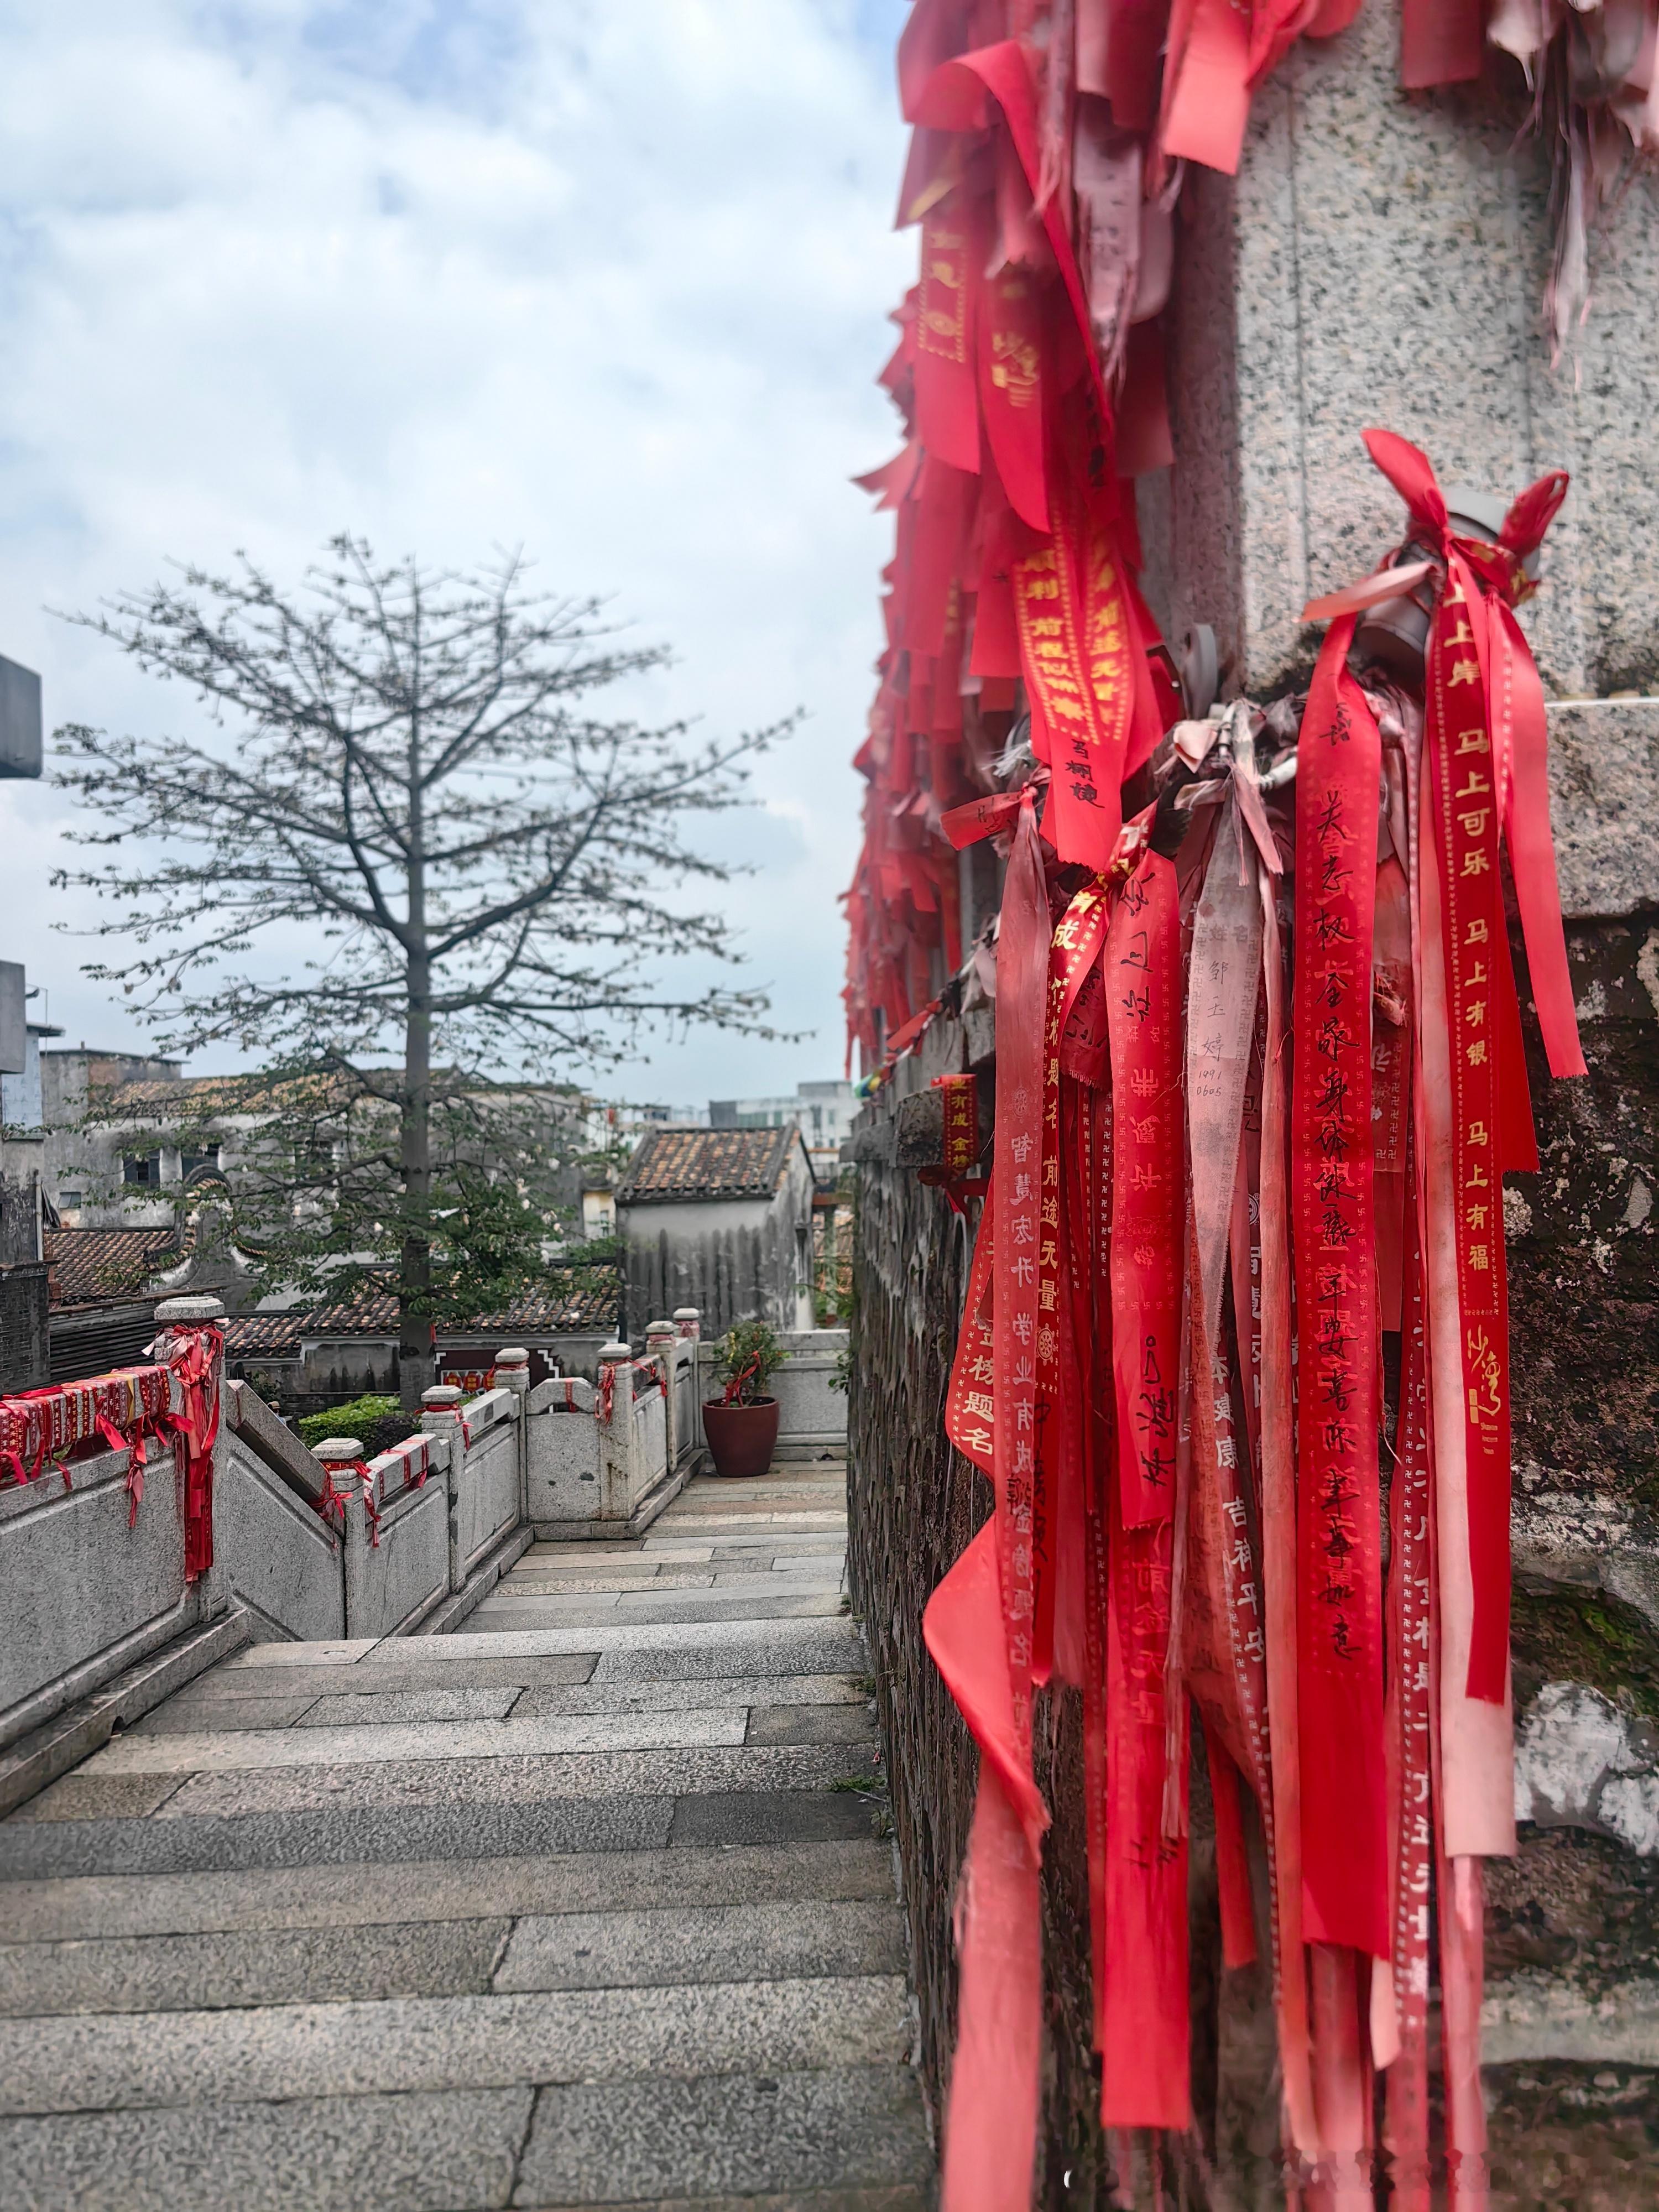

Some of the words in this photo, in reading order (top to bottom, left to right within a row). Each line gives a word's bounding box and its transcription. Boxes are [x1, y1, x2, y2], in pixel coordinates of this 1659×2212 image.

[1454, 728, 1491, 878] 马上可乐
[1051, 890, 1098, 950] 有成
[1464, 918, 1489, 1067] 马上有银
[1465, 1120, 1489, 1271] 马上有福
[1222, 1495, 1265, 1663] 吉祥平安
